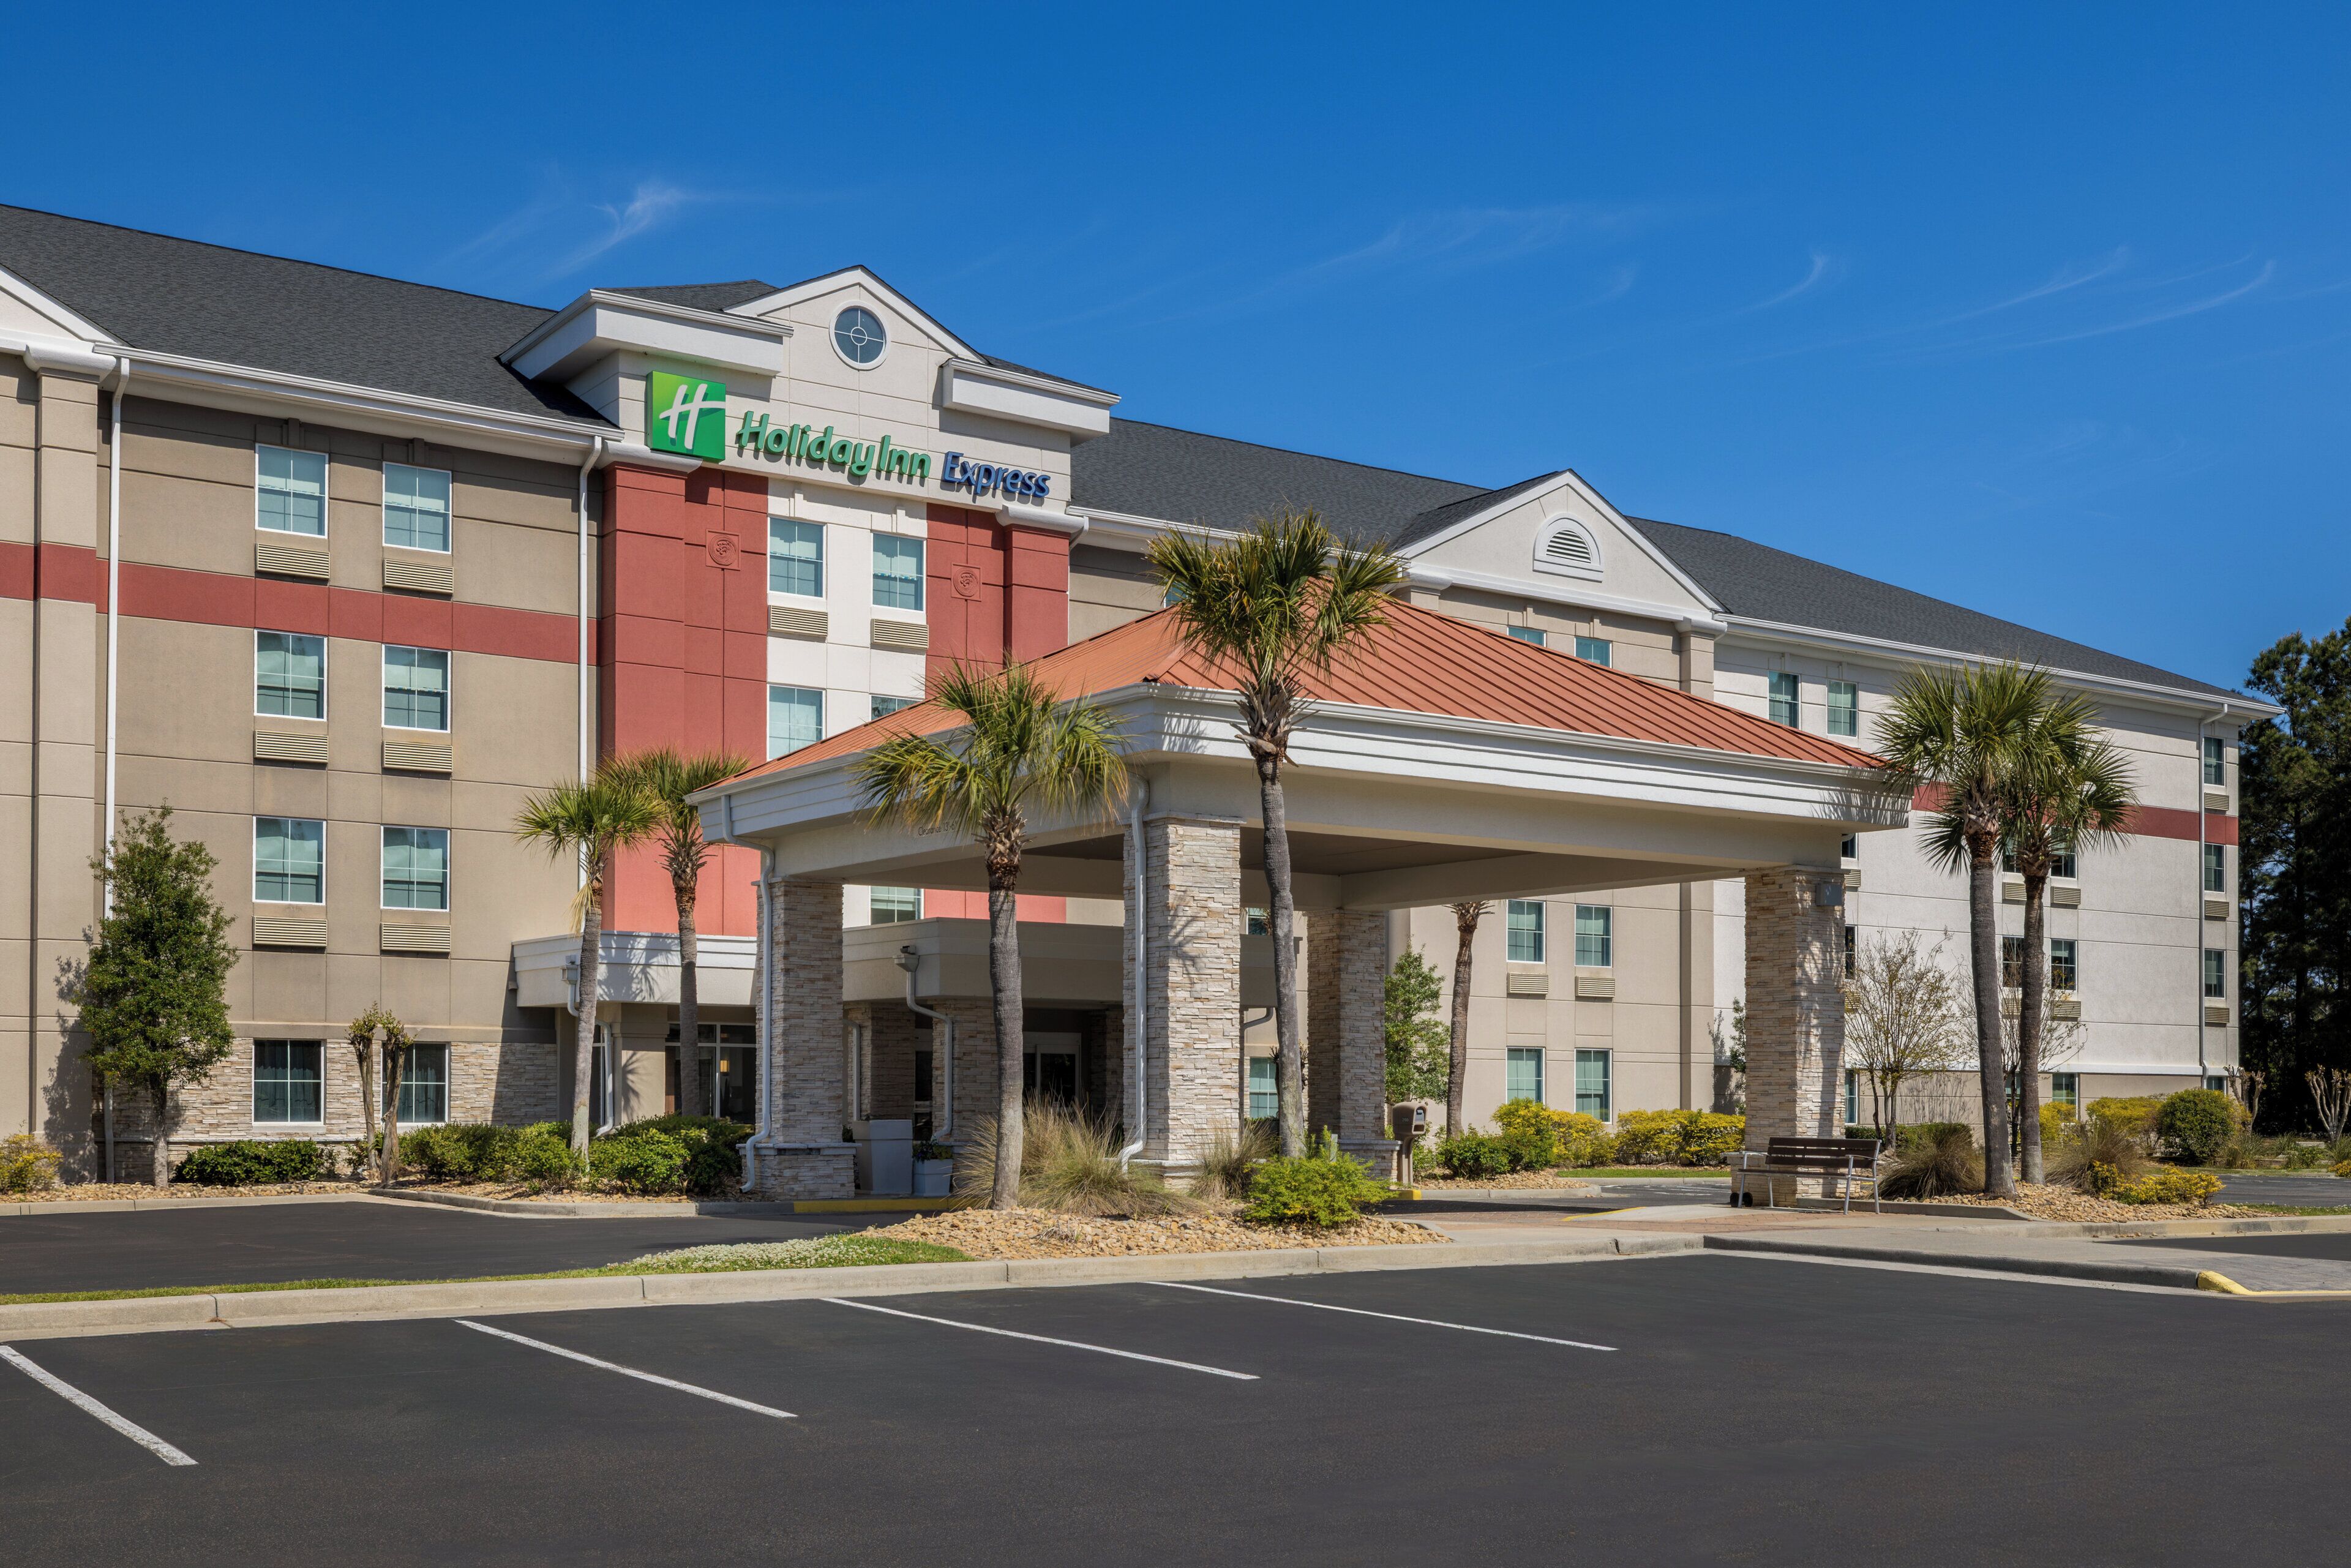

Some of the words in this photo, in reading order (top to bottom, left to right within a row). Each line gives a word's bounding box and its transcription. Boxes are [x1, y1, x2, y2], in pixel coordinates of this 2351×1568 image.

[736, 411, 876, 476] Holiday
[877, 435, 931, 478] Inn
[943, 451, 1051, 498] Express
